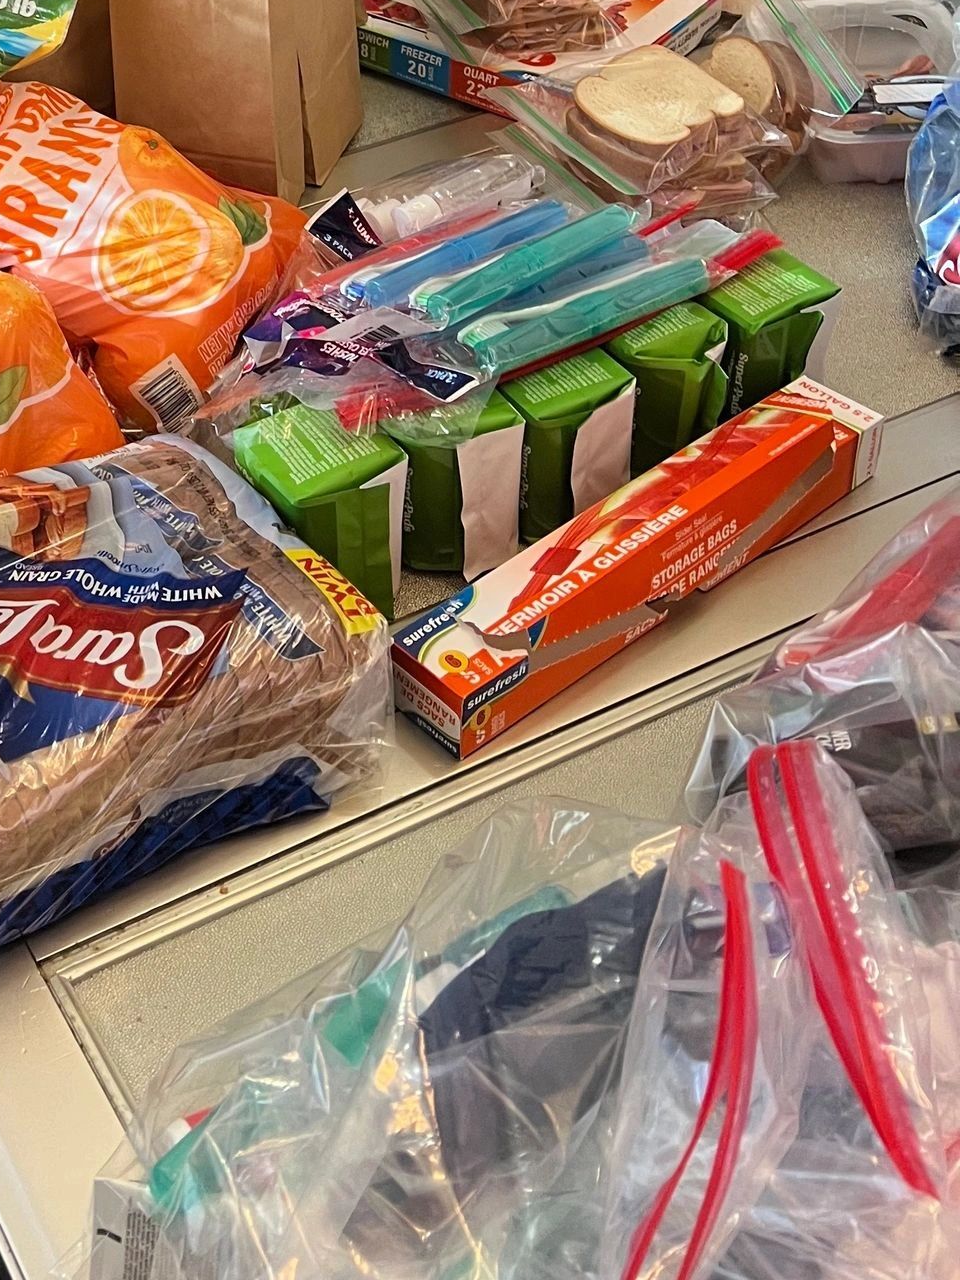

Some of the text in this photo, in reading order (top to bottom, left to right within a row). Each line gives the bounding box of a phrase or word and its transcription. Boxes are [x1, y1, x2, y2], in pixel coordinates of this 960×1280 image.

[400, 45, 443, 67] FREEZER
[463, 65, 500, 86] QUART
[407, 60, 426, 78] 20
[197, 331, 223, 364] NET
[799, 381, 875, 423] 2.5 GALLON
[593, 504, 689, 570] GLISSIÈRE
[652, 519, 738, 589] STORAGE BAGS
[8, 568, 223, 605] WHITE MADE WITH WHOLE GRAIN
[296, 557, 363, 624] TWIN
[402, 600, 464, 648] surefresh
[29, 614, 206, 690] Sara
[444, 654, 462, 668] 6
[399, 685, 446, 728] SACS DE
[466, 665, 527, 711] surefresh
[416, 716, 458, 754] surefresh
